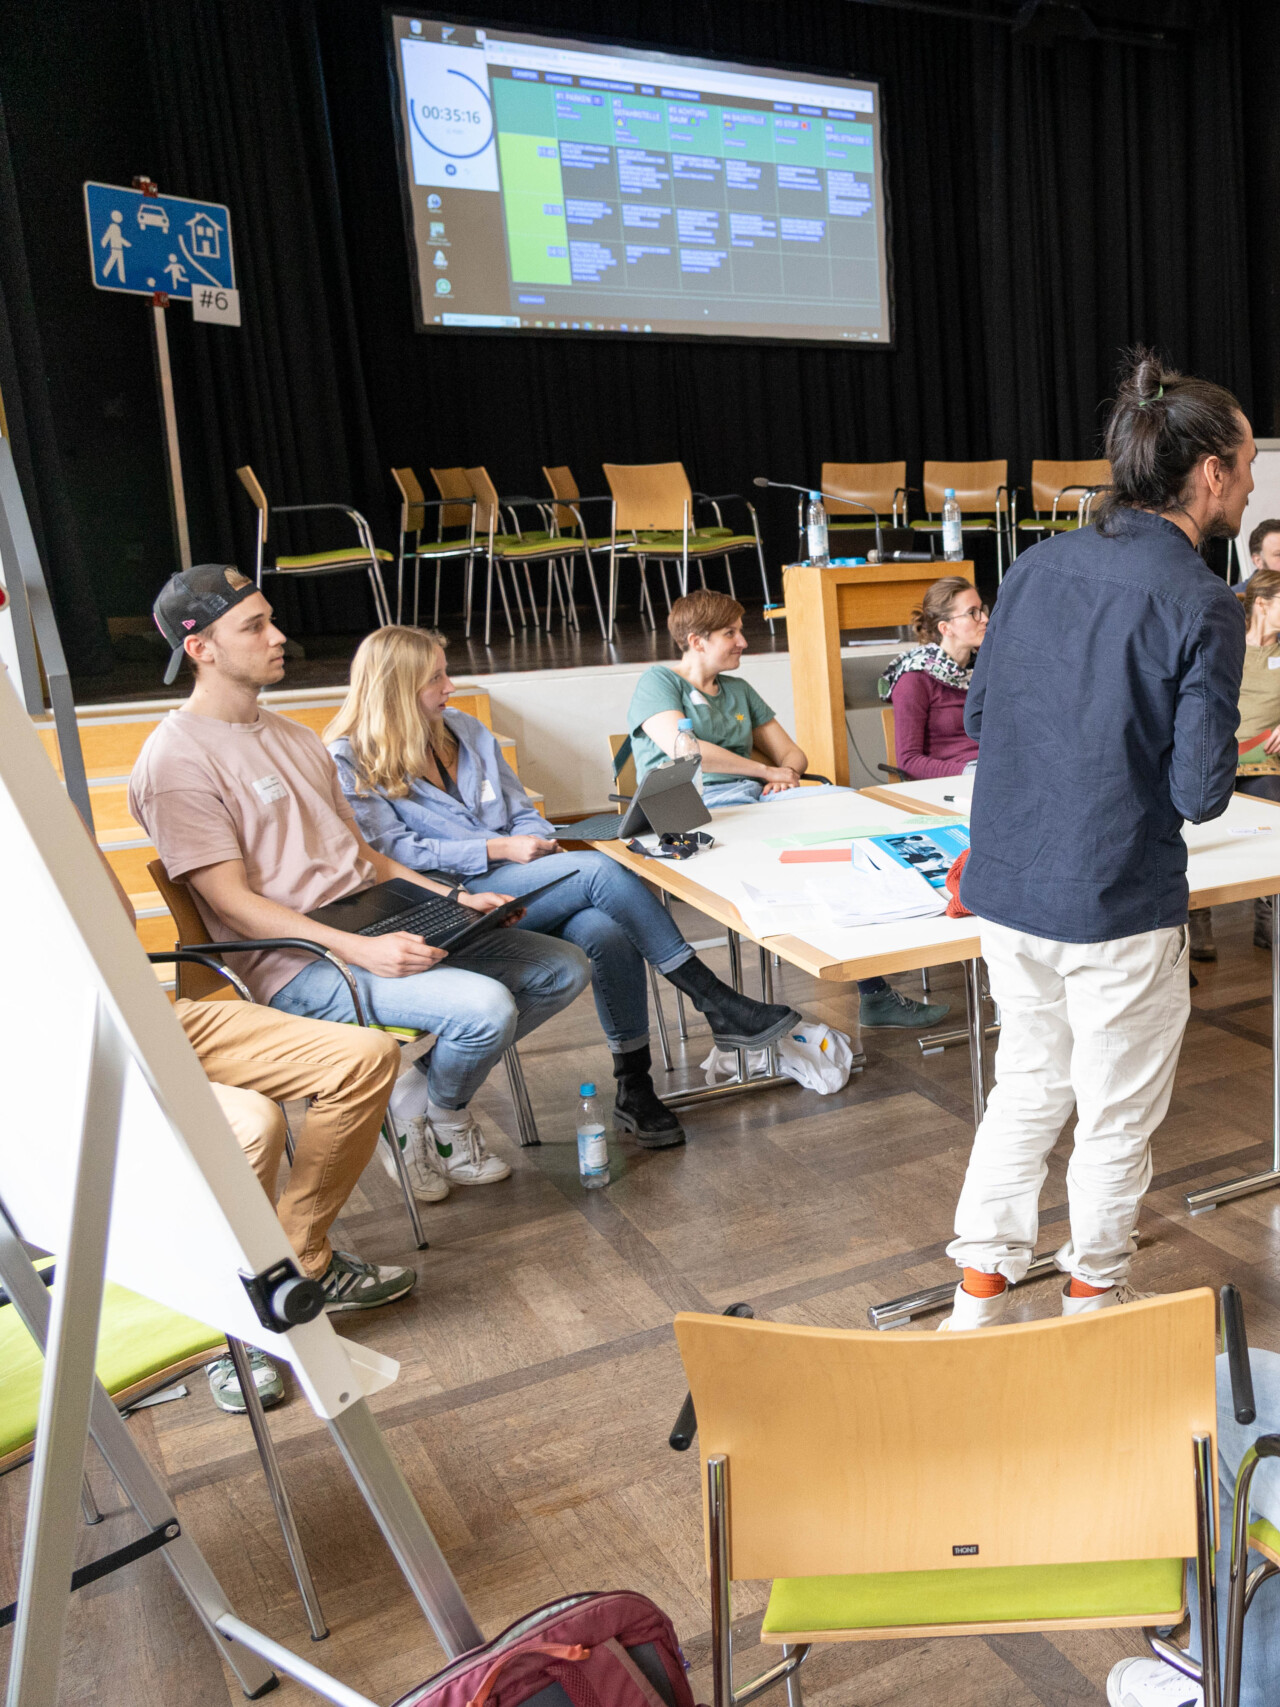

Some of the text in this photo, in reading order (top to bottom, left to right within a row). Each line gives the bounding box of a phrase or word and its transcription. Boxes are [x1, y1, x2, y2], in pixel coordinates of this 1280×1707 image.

[422, 105, 481, 124] 00:35:16
[199, 290, 228, 310] #6
[954, 1546, 977, 1554] THONET
